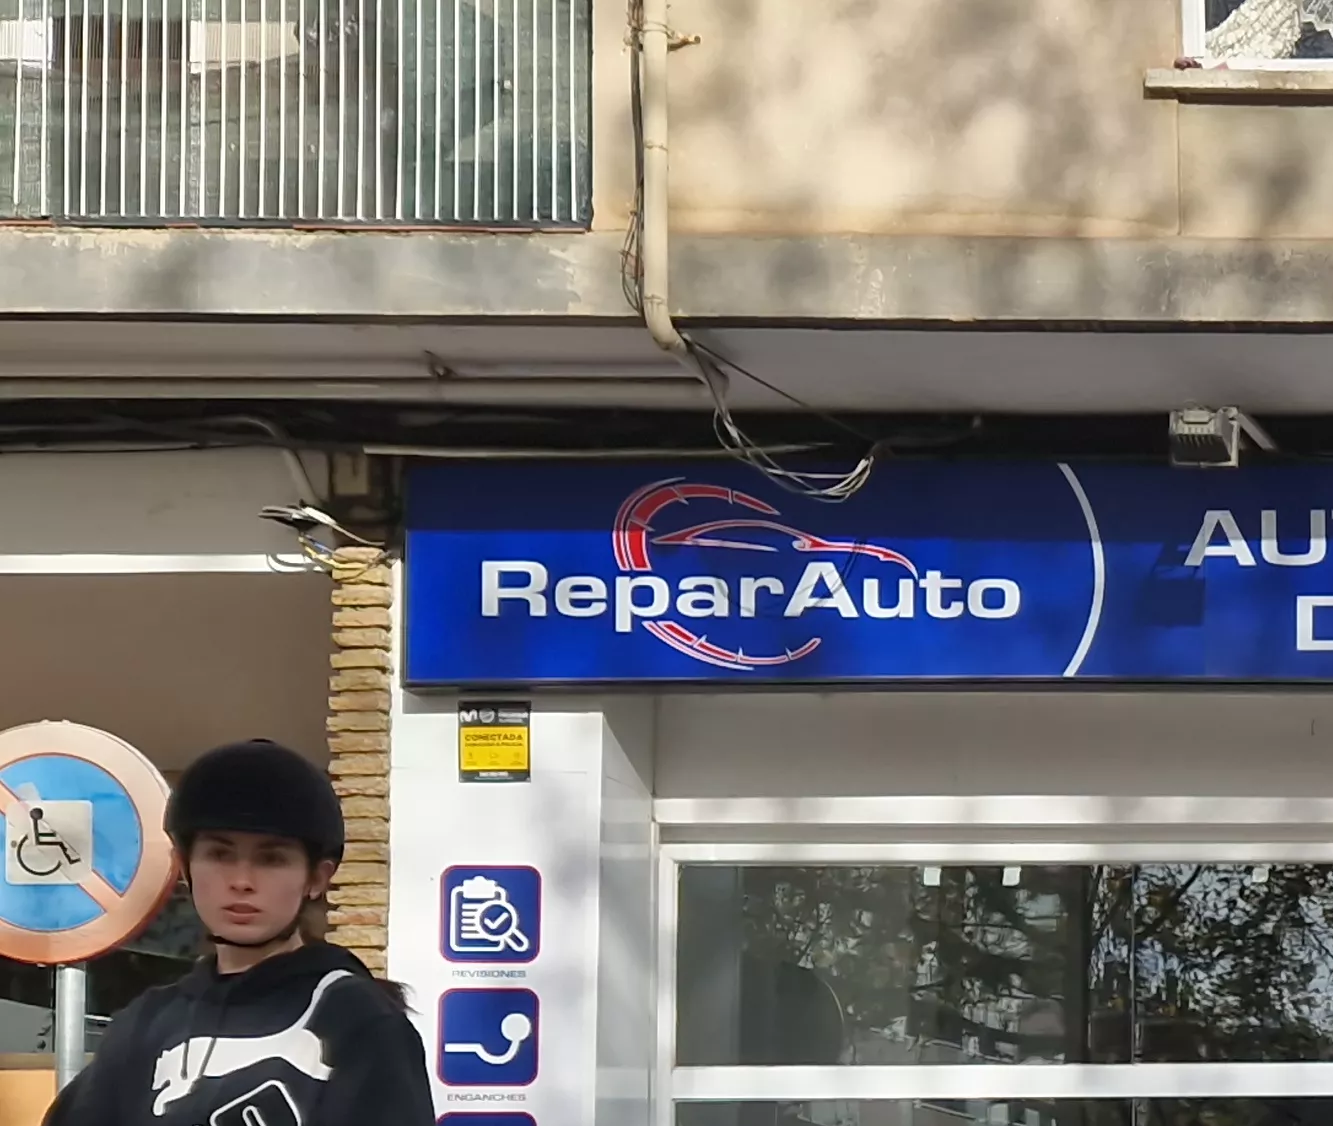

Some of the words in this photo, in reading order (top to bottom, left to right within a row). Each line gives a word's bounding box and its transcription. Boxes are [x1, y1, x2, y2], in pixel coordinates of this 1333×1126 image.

[481, 560, 1021, 633] ReparAuto
[464, 733, 524, 742] CONECTADA
[451, 970, 527, 978] REVISIONES
[446, 1093, 527, 1102] ENGANCHES
